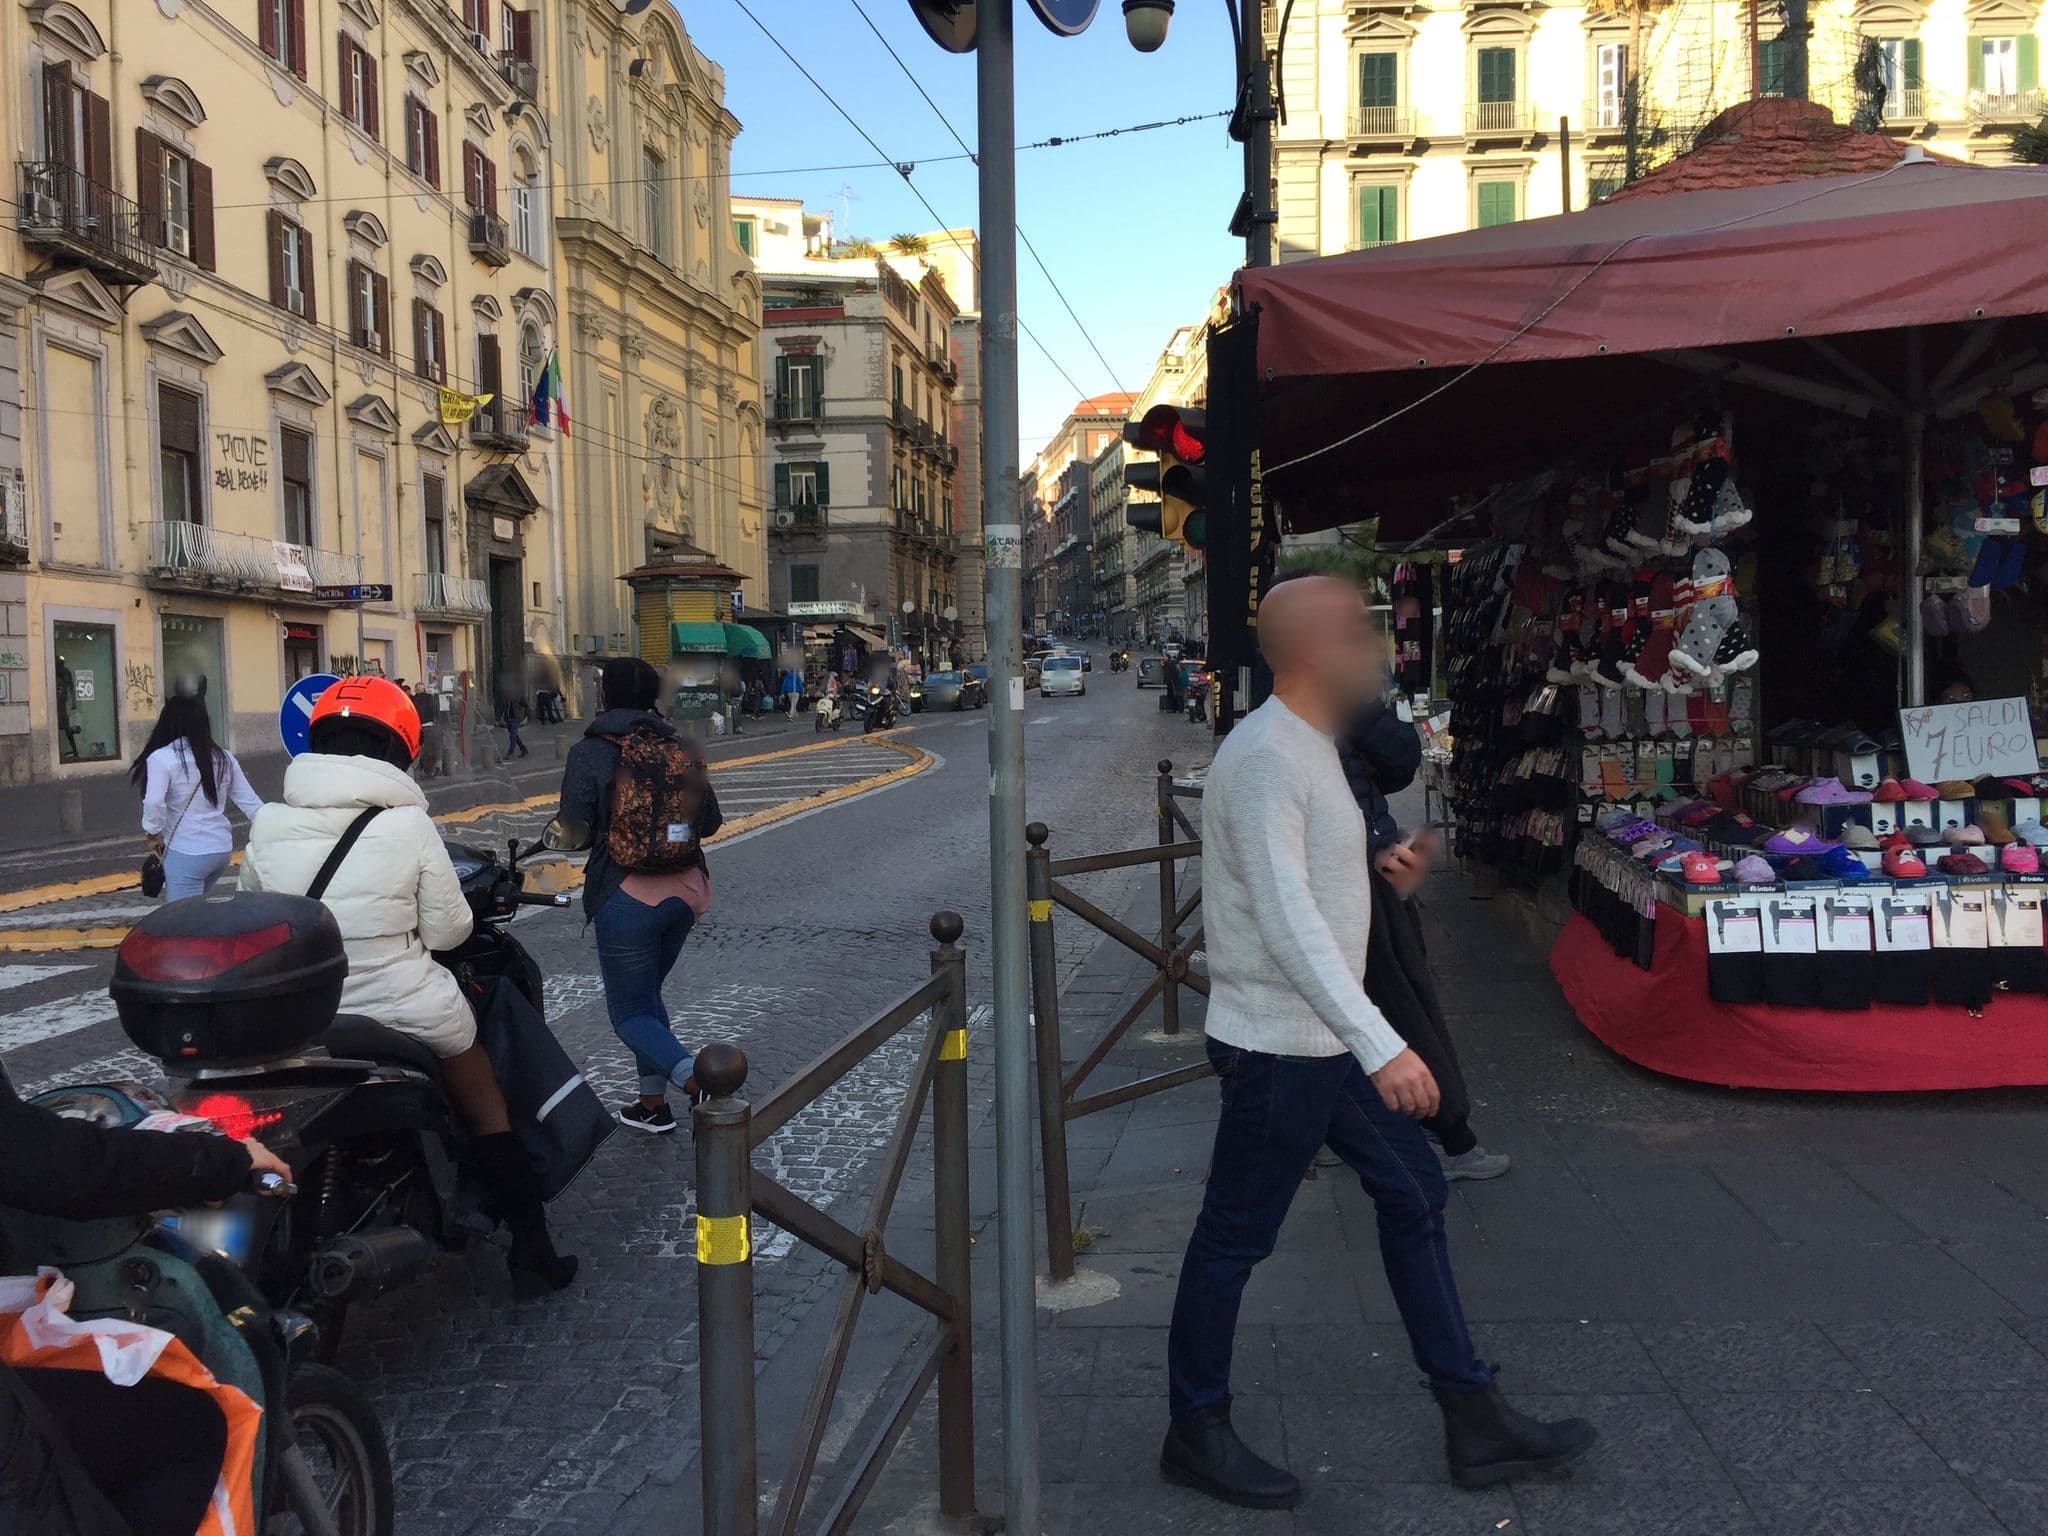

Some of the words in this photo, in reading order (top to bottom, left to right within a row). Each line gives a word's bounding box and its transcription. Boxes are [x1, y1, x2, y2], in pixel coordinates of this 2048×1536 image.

[1954, 699, 2024, 733] SALDI
[1925, 725, 1948, 780] 7
[1952, 731, 2028, 767] EURO
